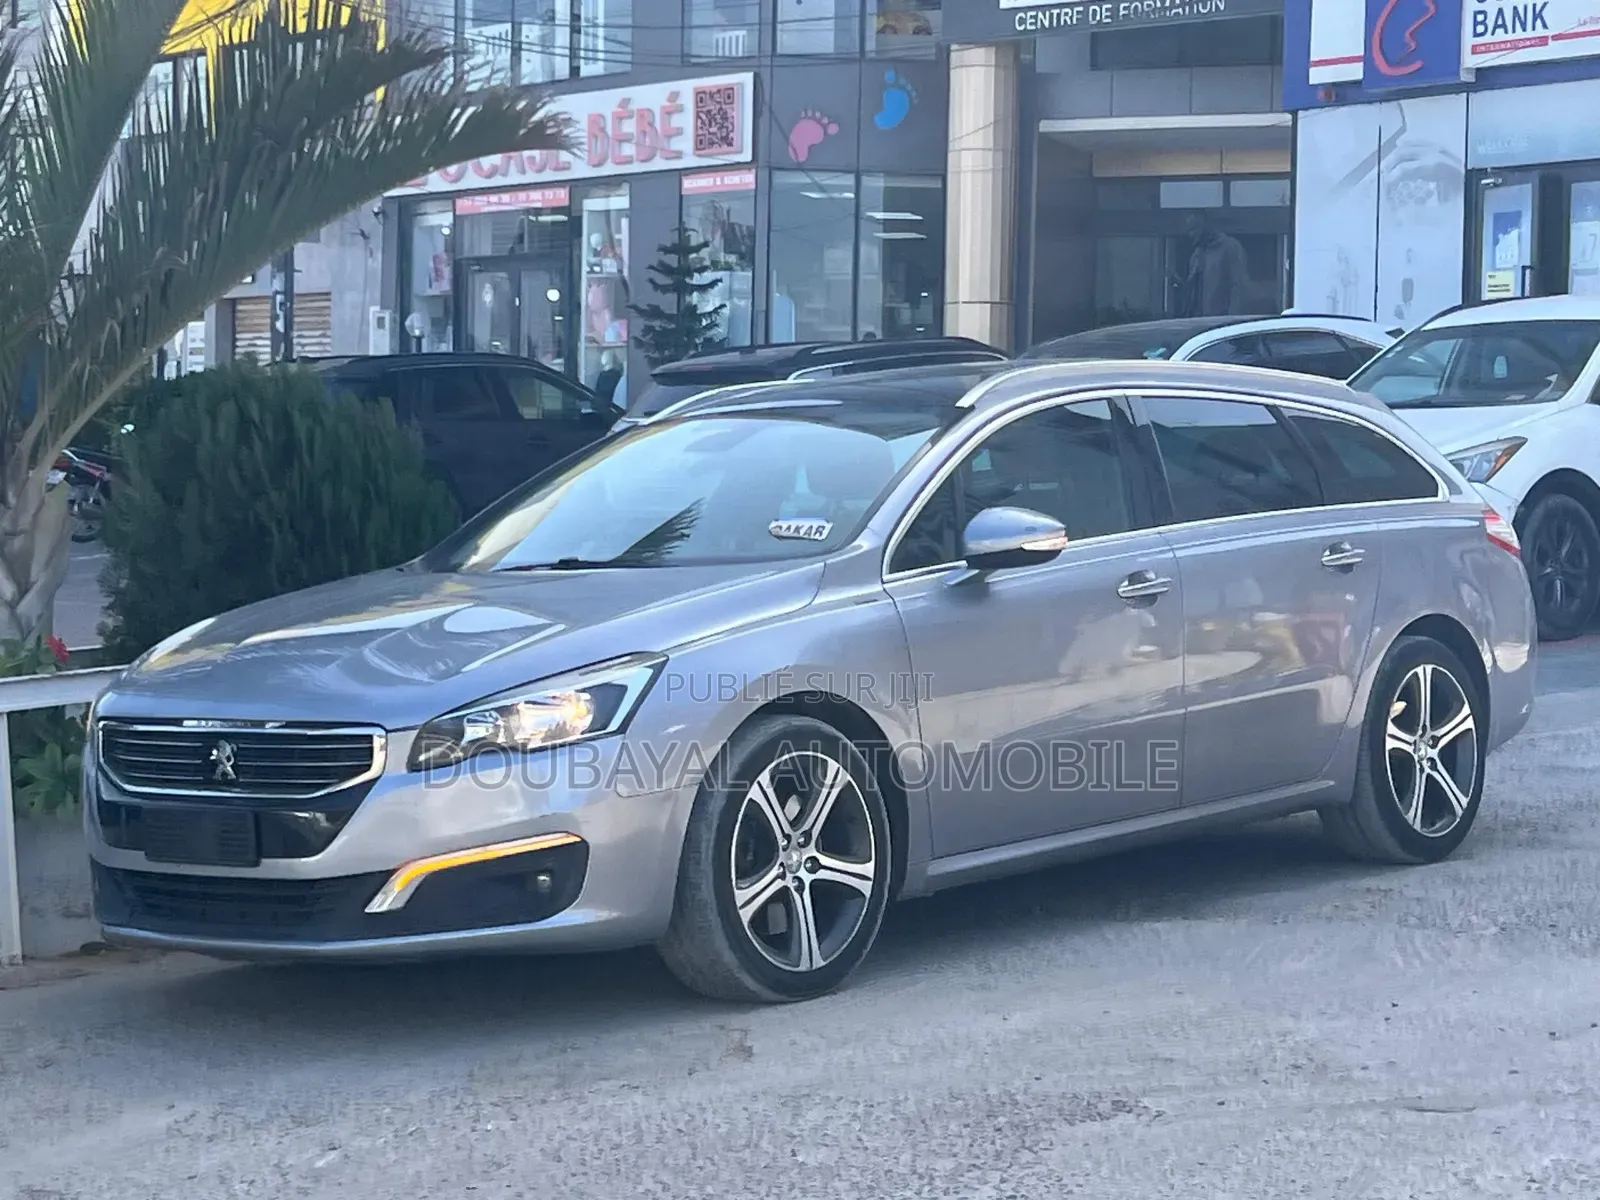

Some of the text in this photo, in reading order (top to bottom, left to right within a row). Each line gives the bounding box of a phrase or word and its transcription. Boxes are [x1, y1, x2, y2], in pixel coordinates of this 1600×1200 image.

[1089, 4, 1112, 25] DE
[1472, 1, 1549, 38] BANK
[587, 91, 684, 167] BÉBÉ
